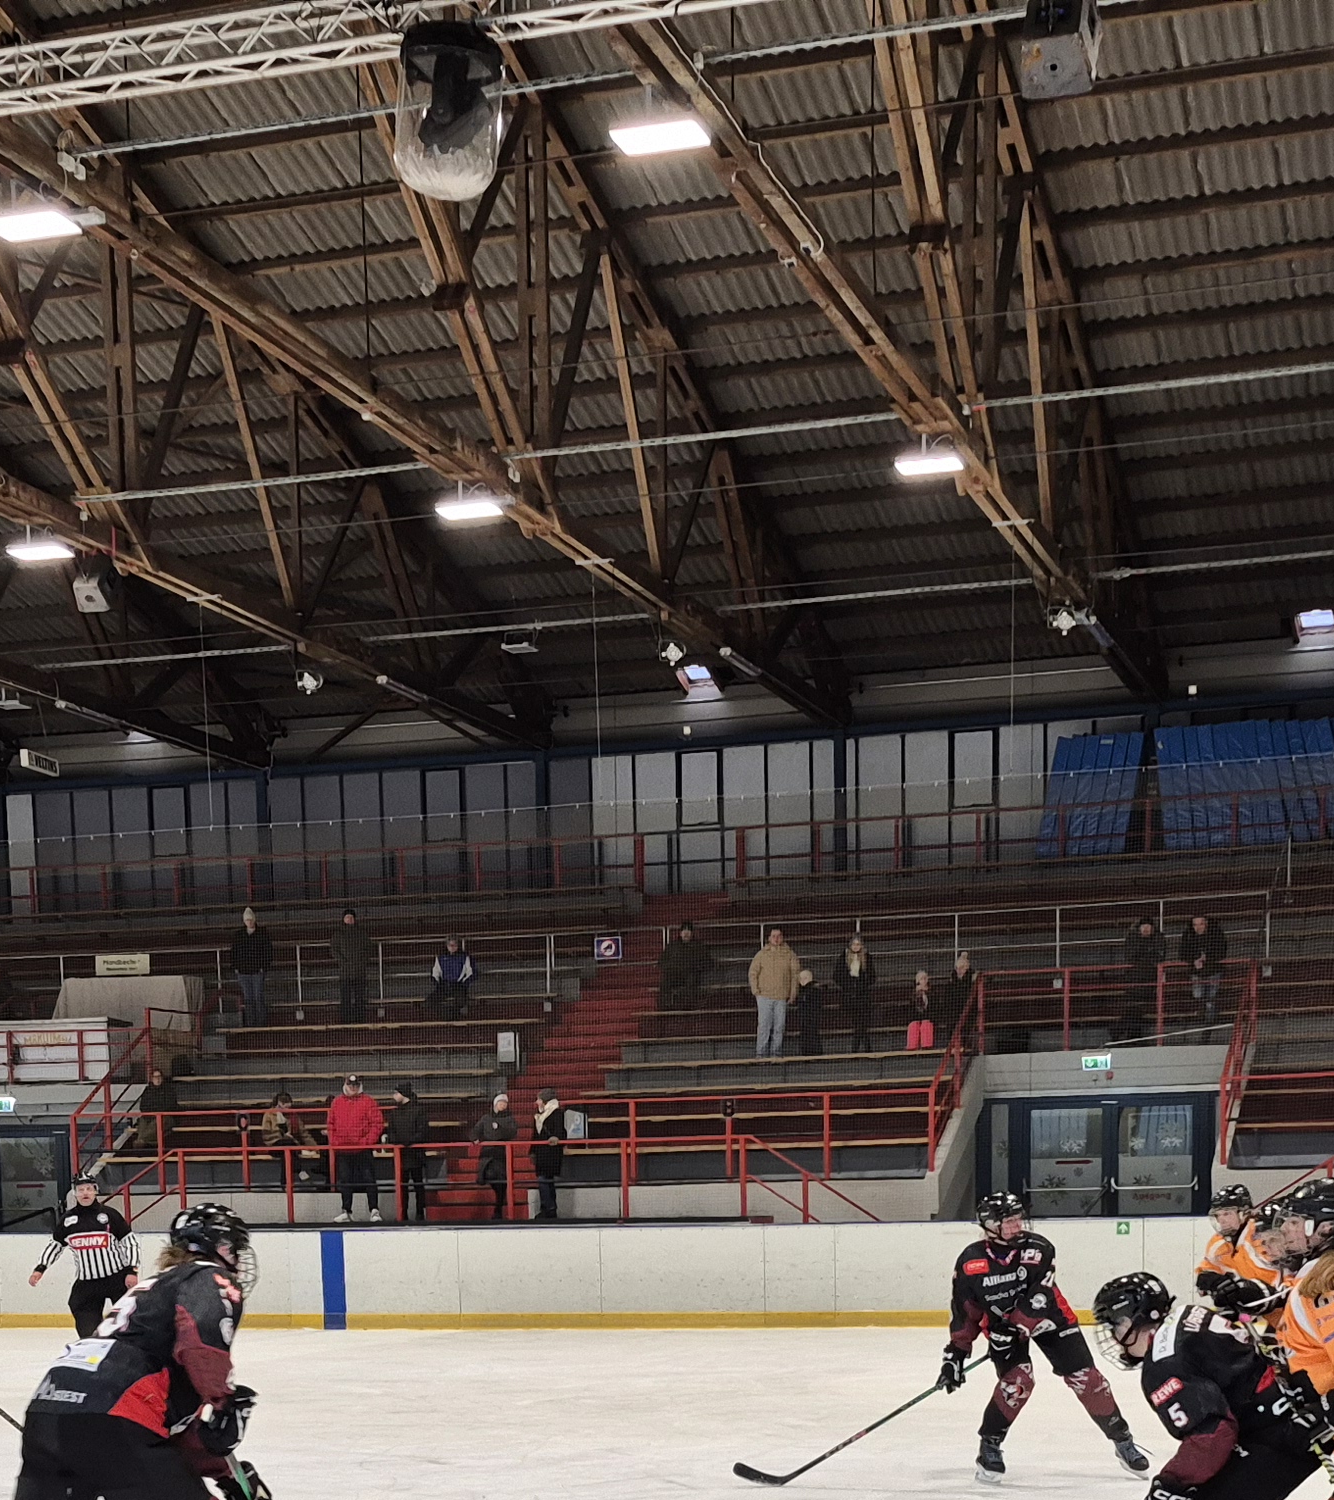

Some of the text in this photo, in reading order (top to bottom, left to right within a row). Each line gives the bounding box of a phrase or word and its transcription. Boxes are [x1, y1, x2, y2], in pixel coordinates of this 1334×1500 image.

[982, 1271, 1017, 1287] Allianz
[1150, 1378, 1182, 1405] REWE
[1167, 1402, 1188, 1428] 5
